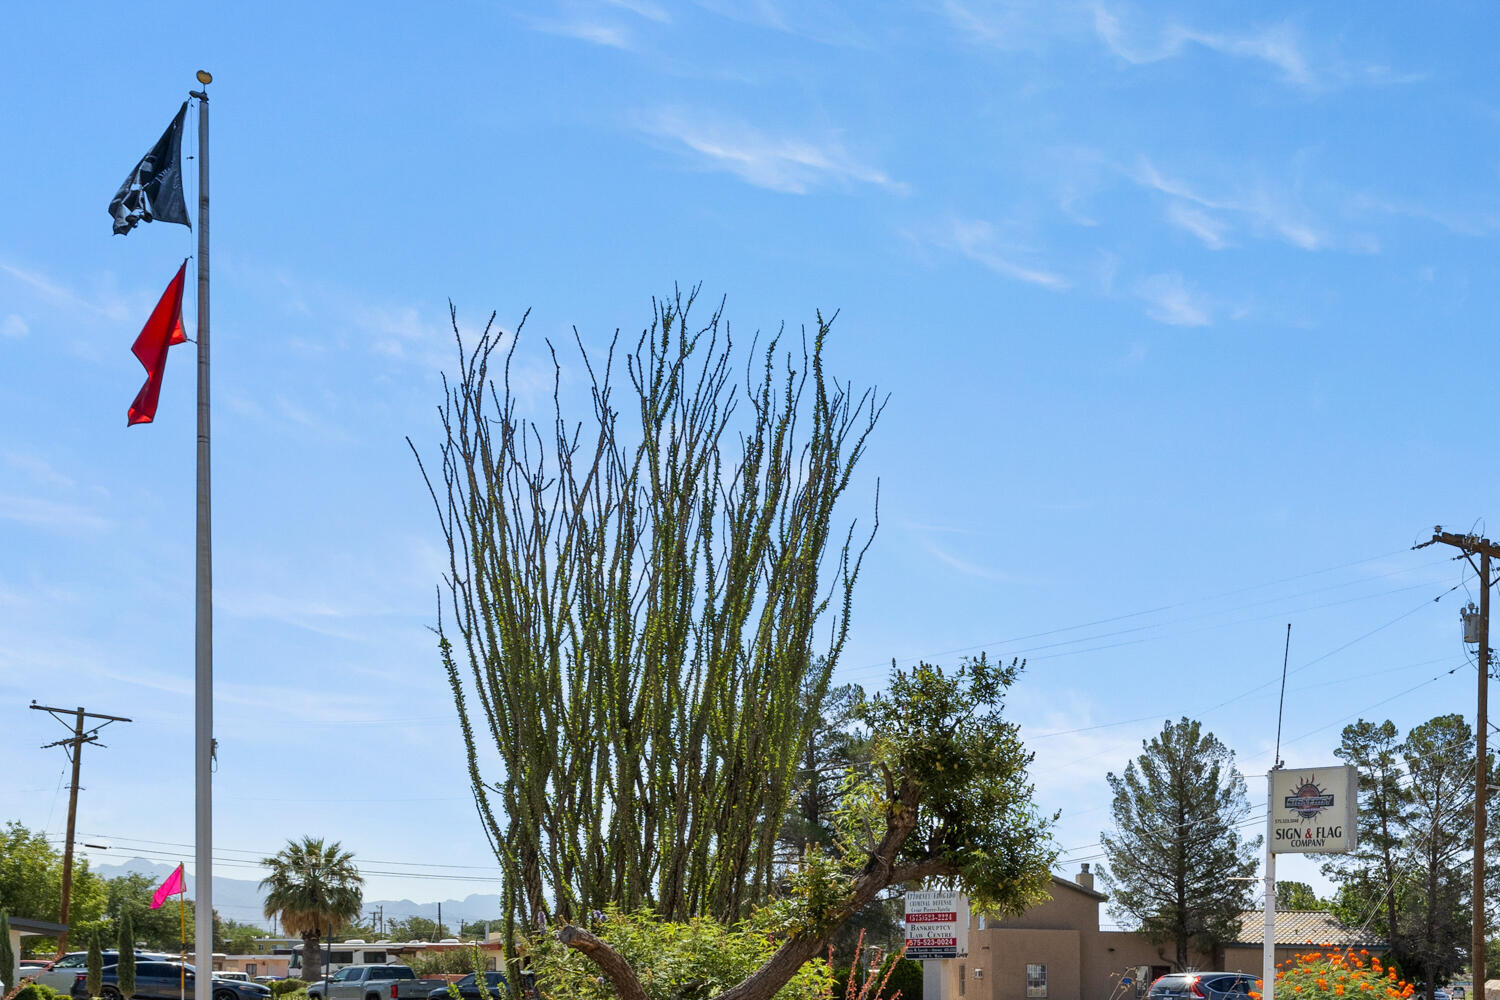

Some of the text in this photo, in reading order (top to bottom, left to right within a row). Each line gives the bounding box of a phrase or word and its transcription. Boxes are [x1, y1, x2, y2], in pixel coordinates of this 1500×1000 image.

[1275, 826, 1342, 840] SIGN & FLAG
[1290, 839, 1326, 847] COMPANY
[909, 931, 924, 939] LAW
